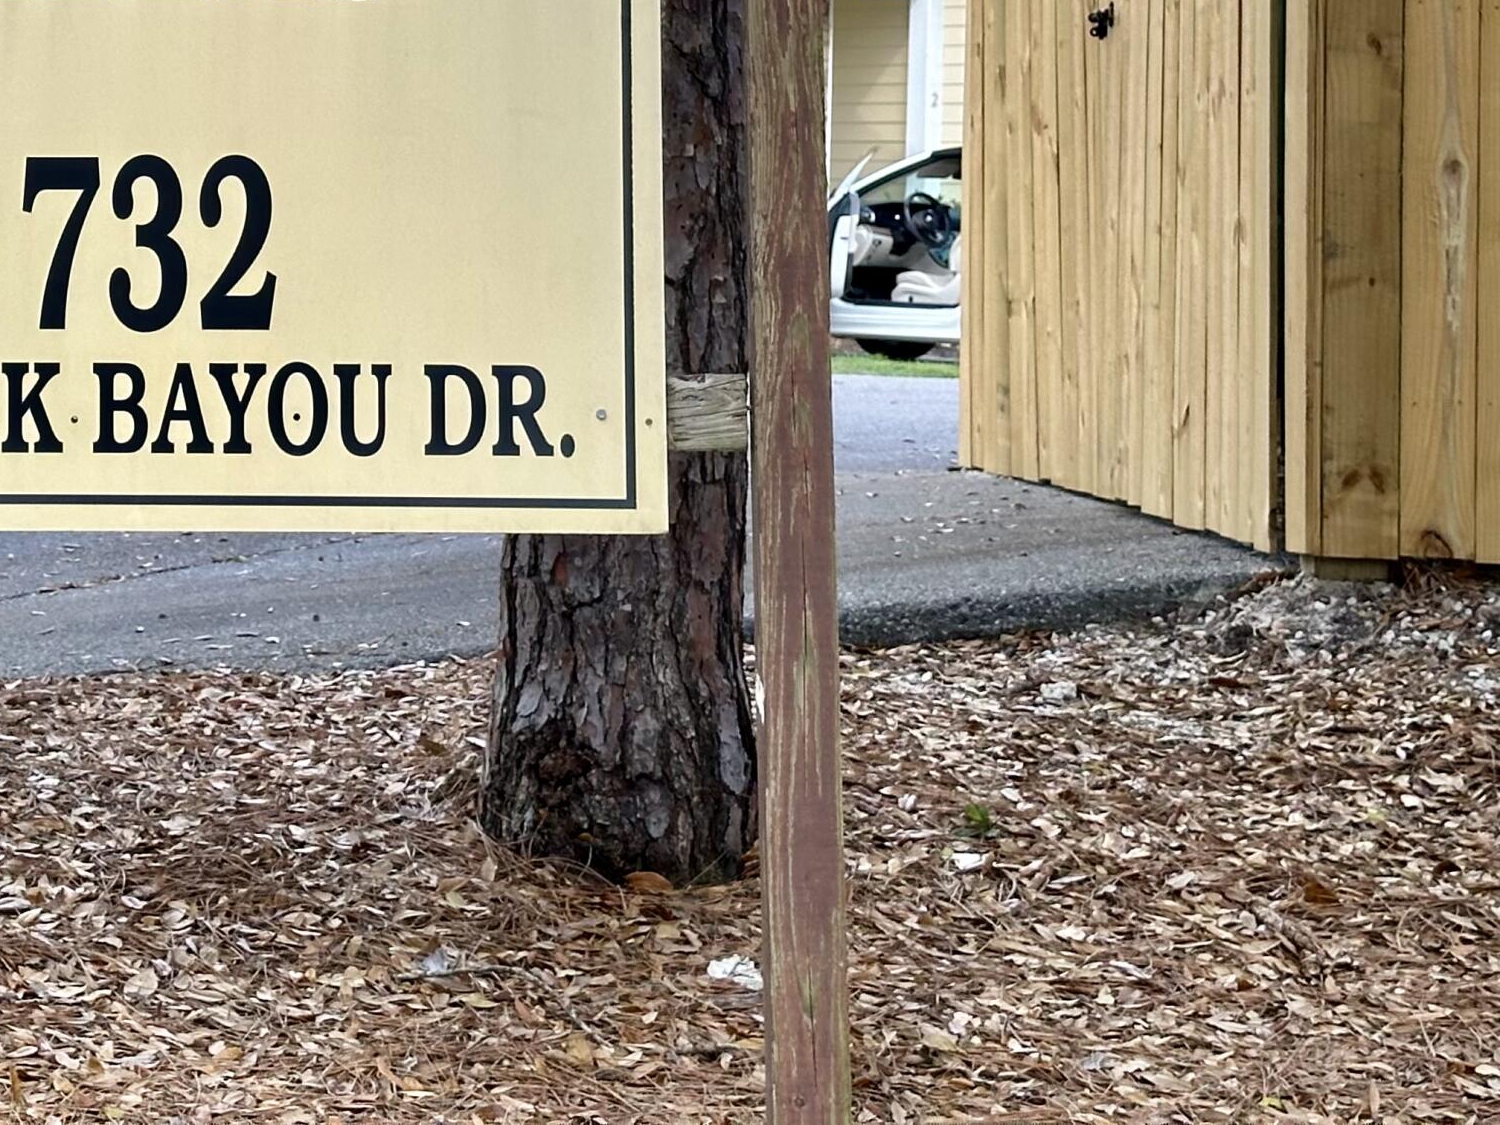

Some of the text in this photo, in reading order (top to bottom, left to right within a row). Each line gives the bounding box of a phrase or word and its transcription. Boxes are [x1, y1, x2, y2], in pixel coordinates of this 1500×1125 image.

[22, 154, 277, 333] 732
[92, 361, 392, 457] BAYOU
[423, 364, 576, 458] DR.
